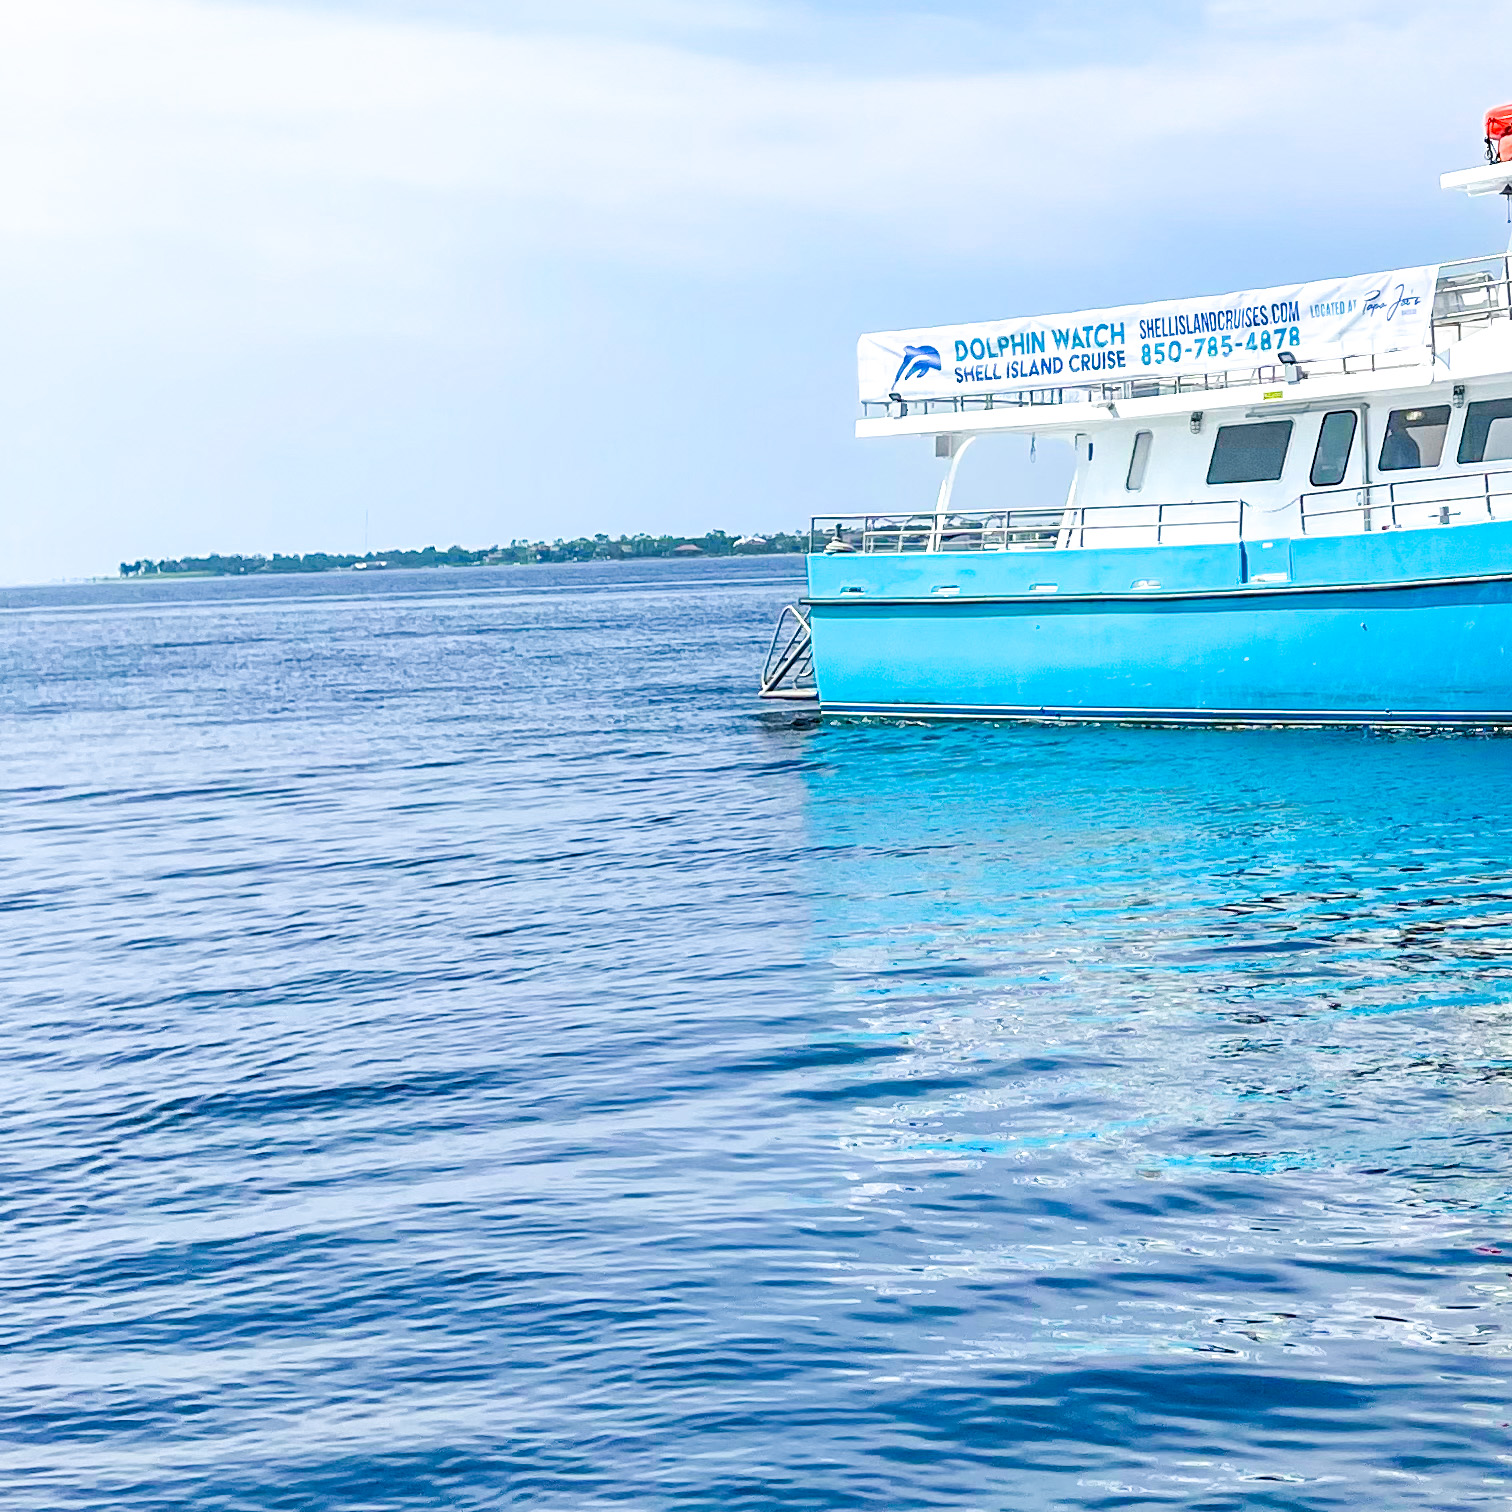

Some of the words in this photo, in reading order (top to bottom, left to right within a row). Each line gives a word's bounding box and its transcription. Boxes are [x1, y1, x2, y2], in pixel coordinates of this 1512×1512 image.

[1139, 301, 1300, 339] SHELLISLANDCRUISES.COM
[1310, 301, 1345, 318] LOCATED
[955, 331, 1045, 361] DOLPHIN
[1051, 322, 1126, 350] WATCH
[1141, 326, 1300, 365] 850-785-4878
[955, 363, 1002, 383] SHELL
[1006, 357, 1064, 378] ISLAND
[1069, 350, 1126, 372] CRUISE
